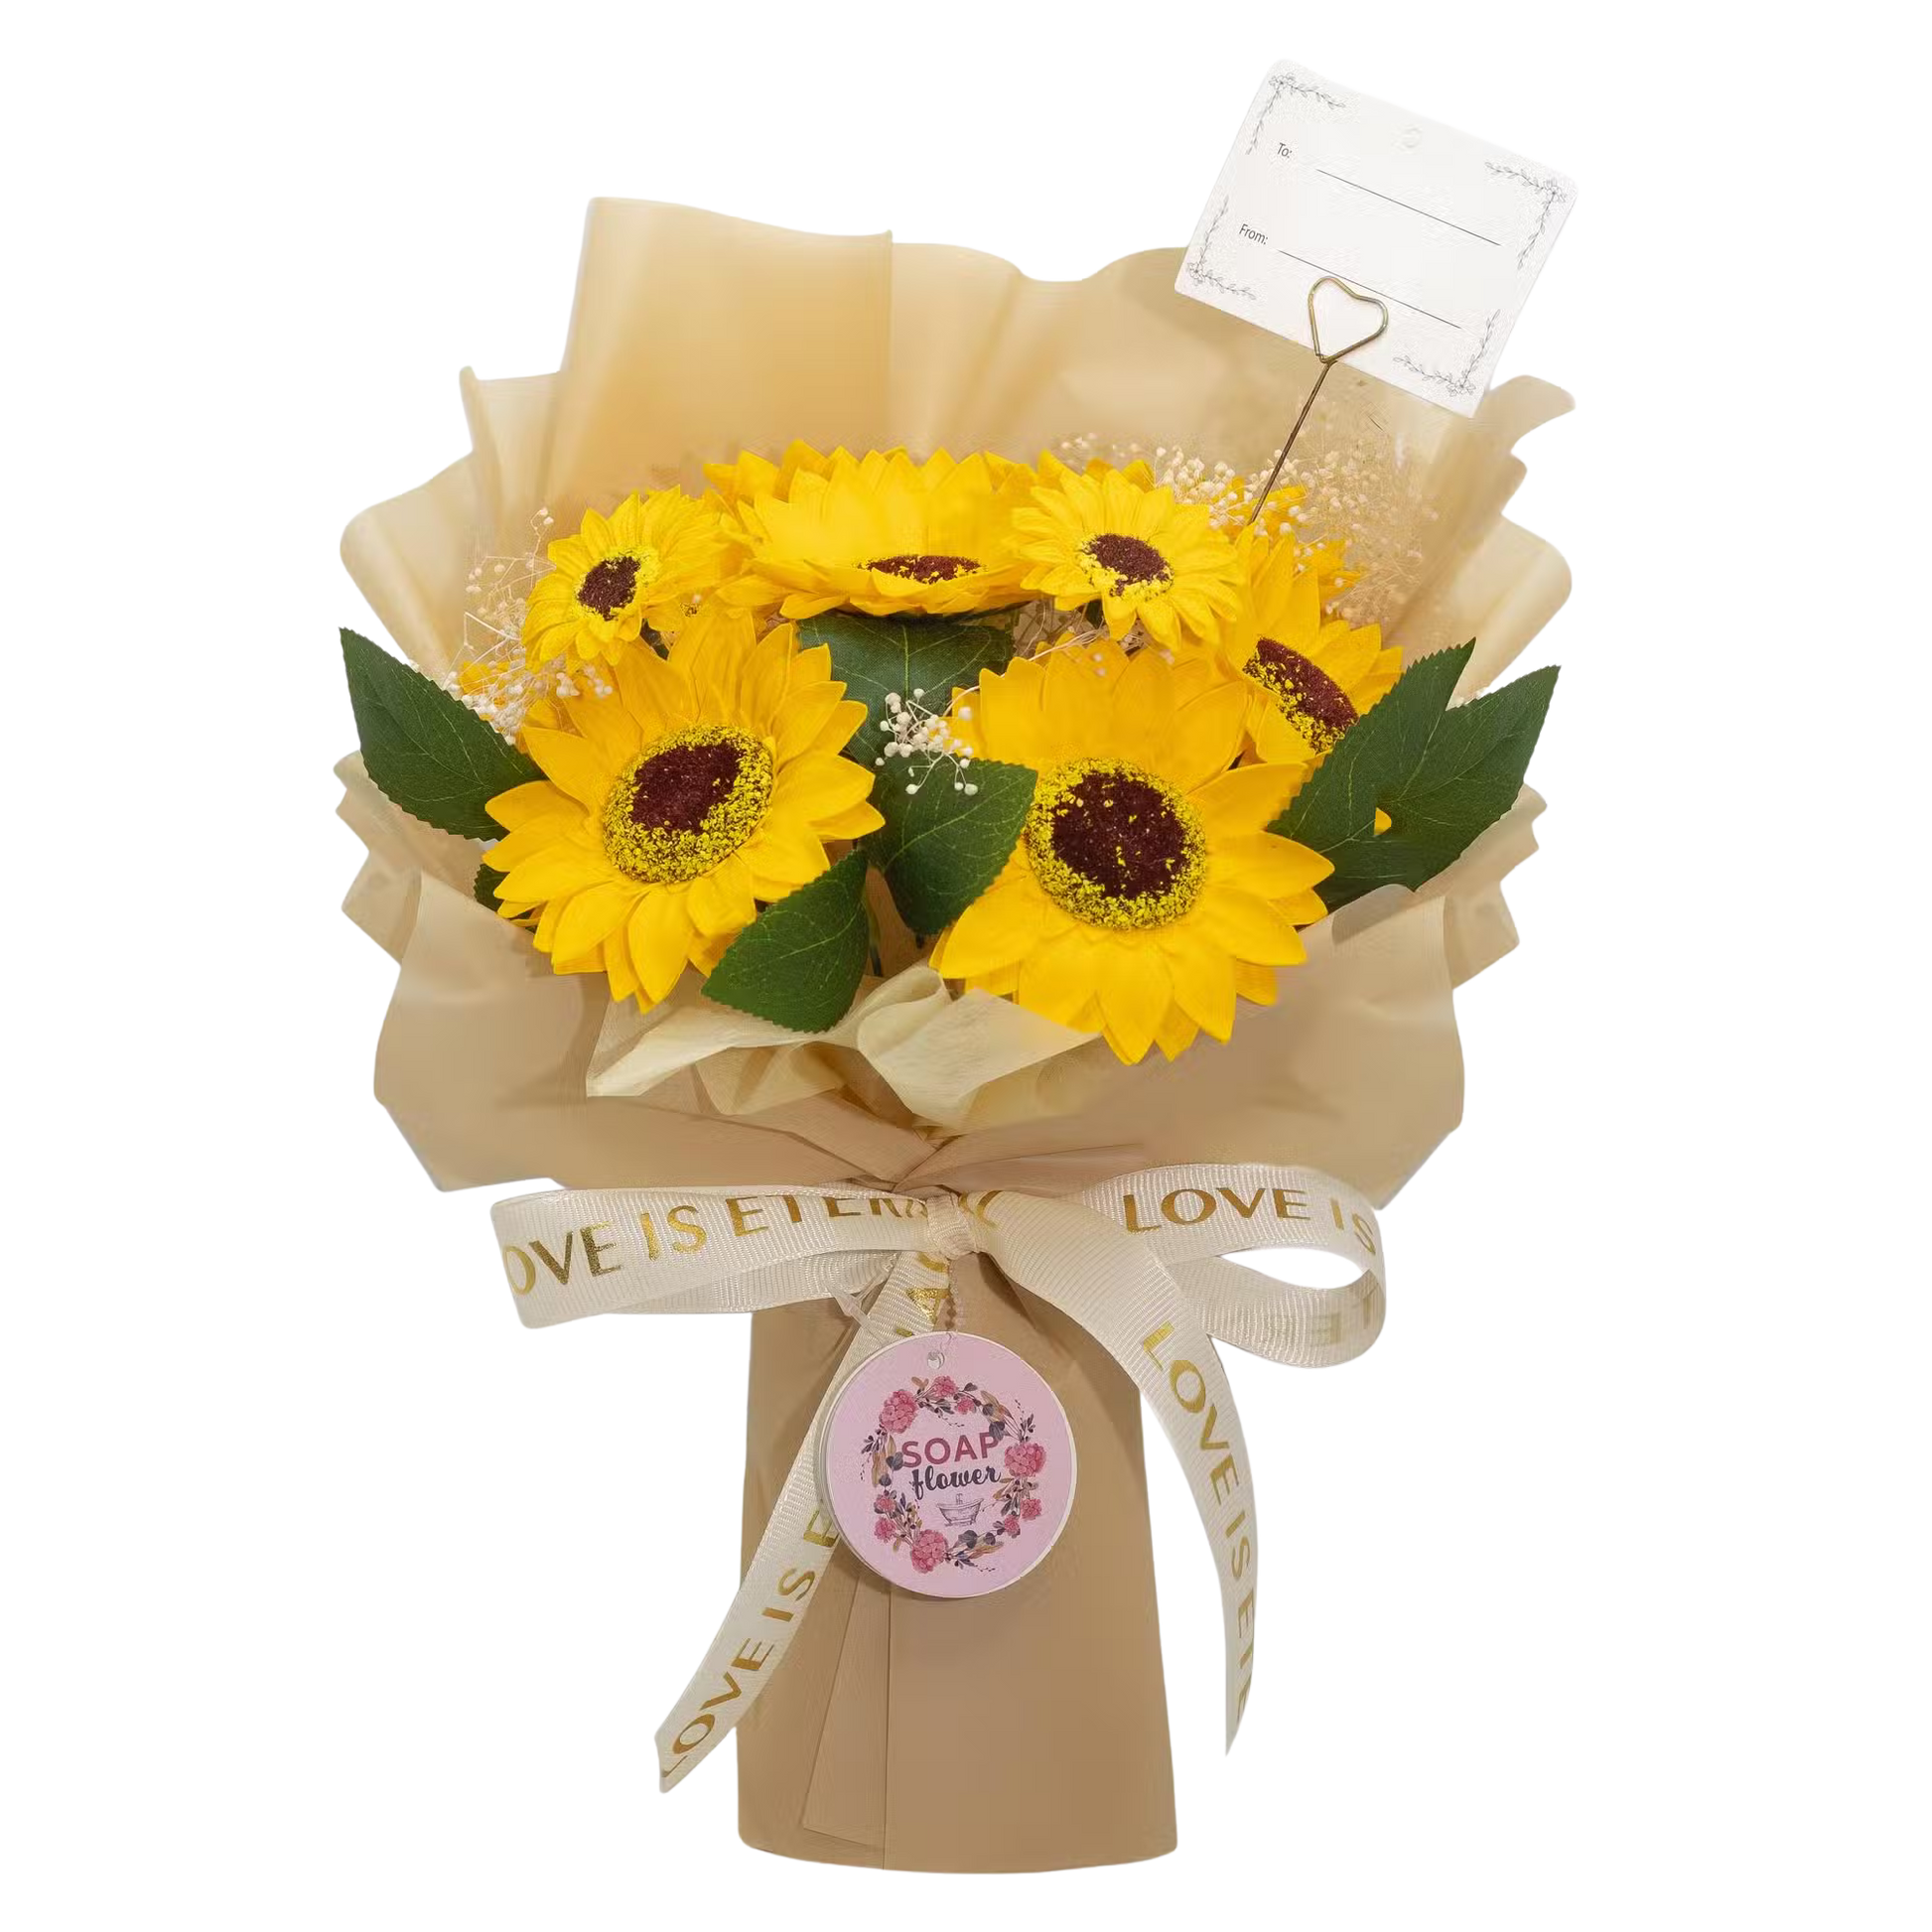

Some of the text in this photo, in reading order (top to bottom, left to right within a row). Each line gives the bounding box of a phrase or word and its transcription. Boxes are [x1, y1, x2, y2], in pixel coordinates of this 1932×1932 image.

[1277, 142, 1293, 159] To:
[1238, 223, 1269, 245] From:
[1123, 1187, 1377, 1256] LOVE IS
[502, 1220, 621, 1296] OVE
[640, 1204, 708, 1262] IS
[899, 1432, 1000, 1468] SOAP
[1143, 1320, 1240, 1506] LOVE
[1225, 1510, 1251, 1582] IS
[908, 1464, 1002, 1501] flower
[761, 1568, 816, 1623] IS
